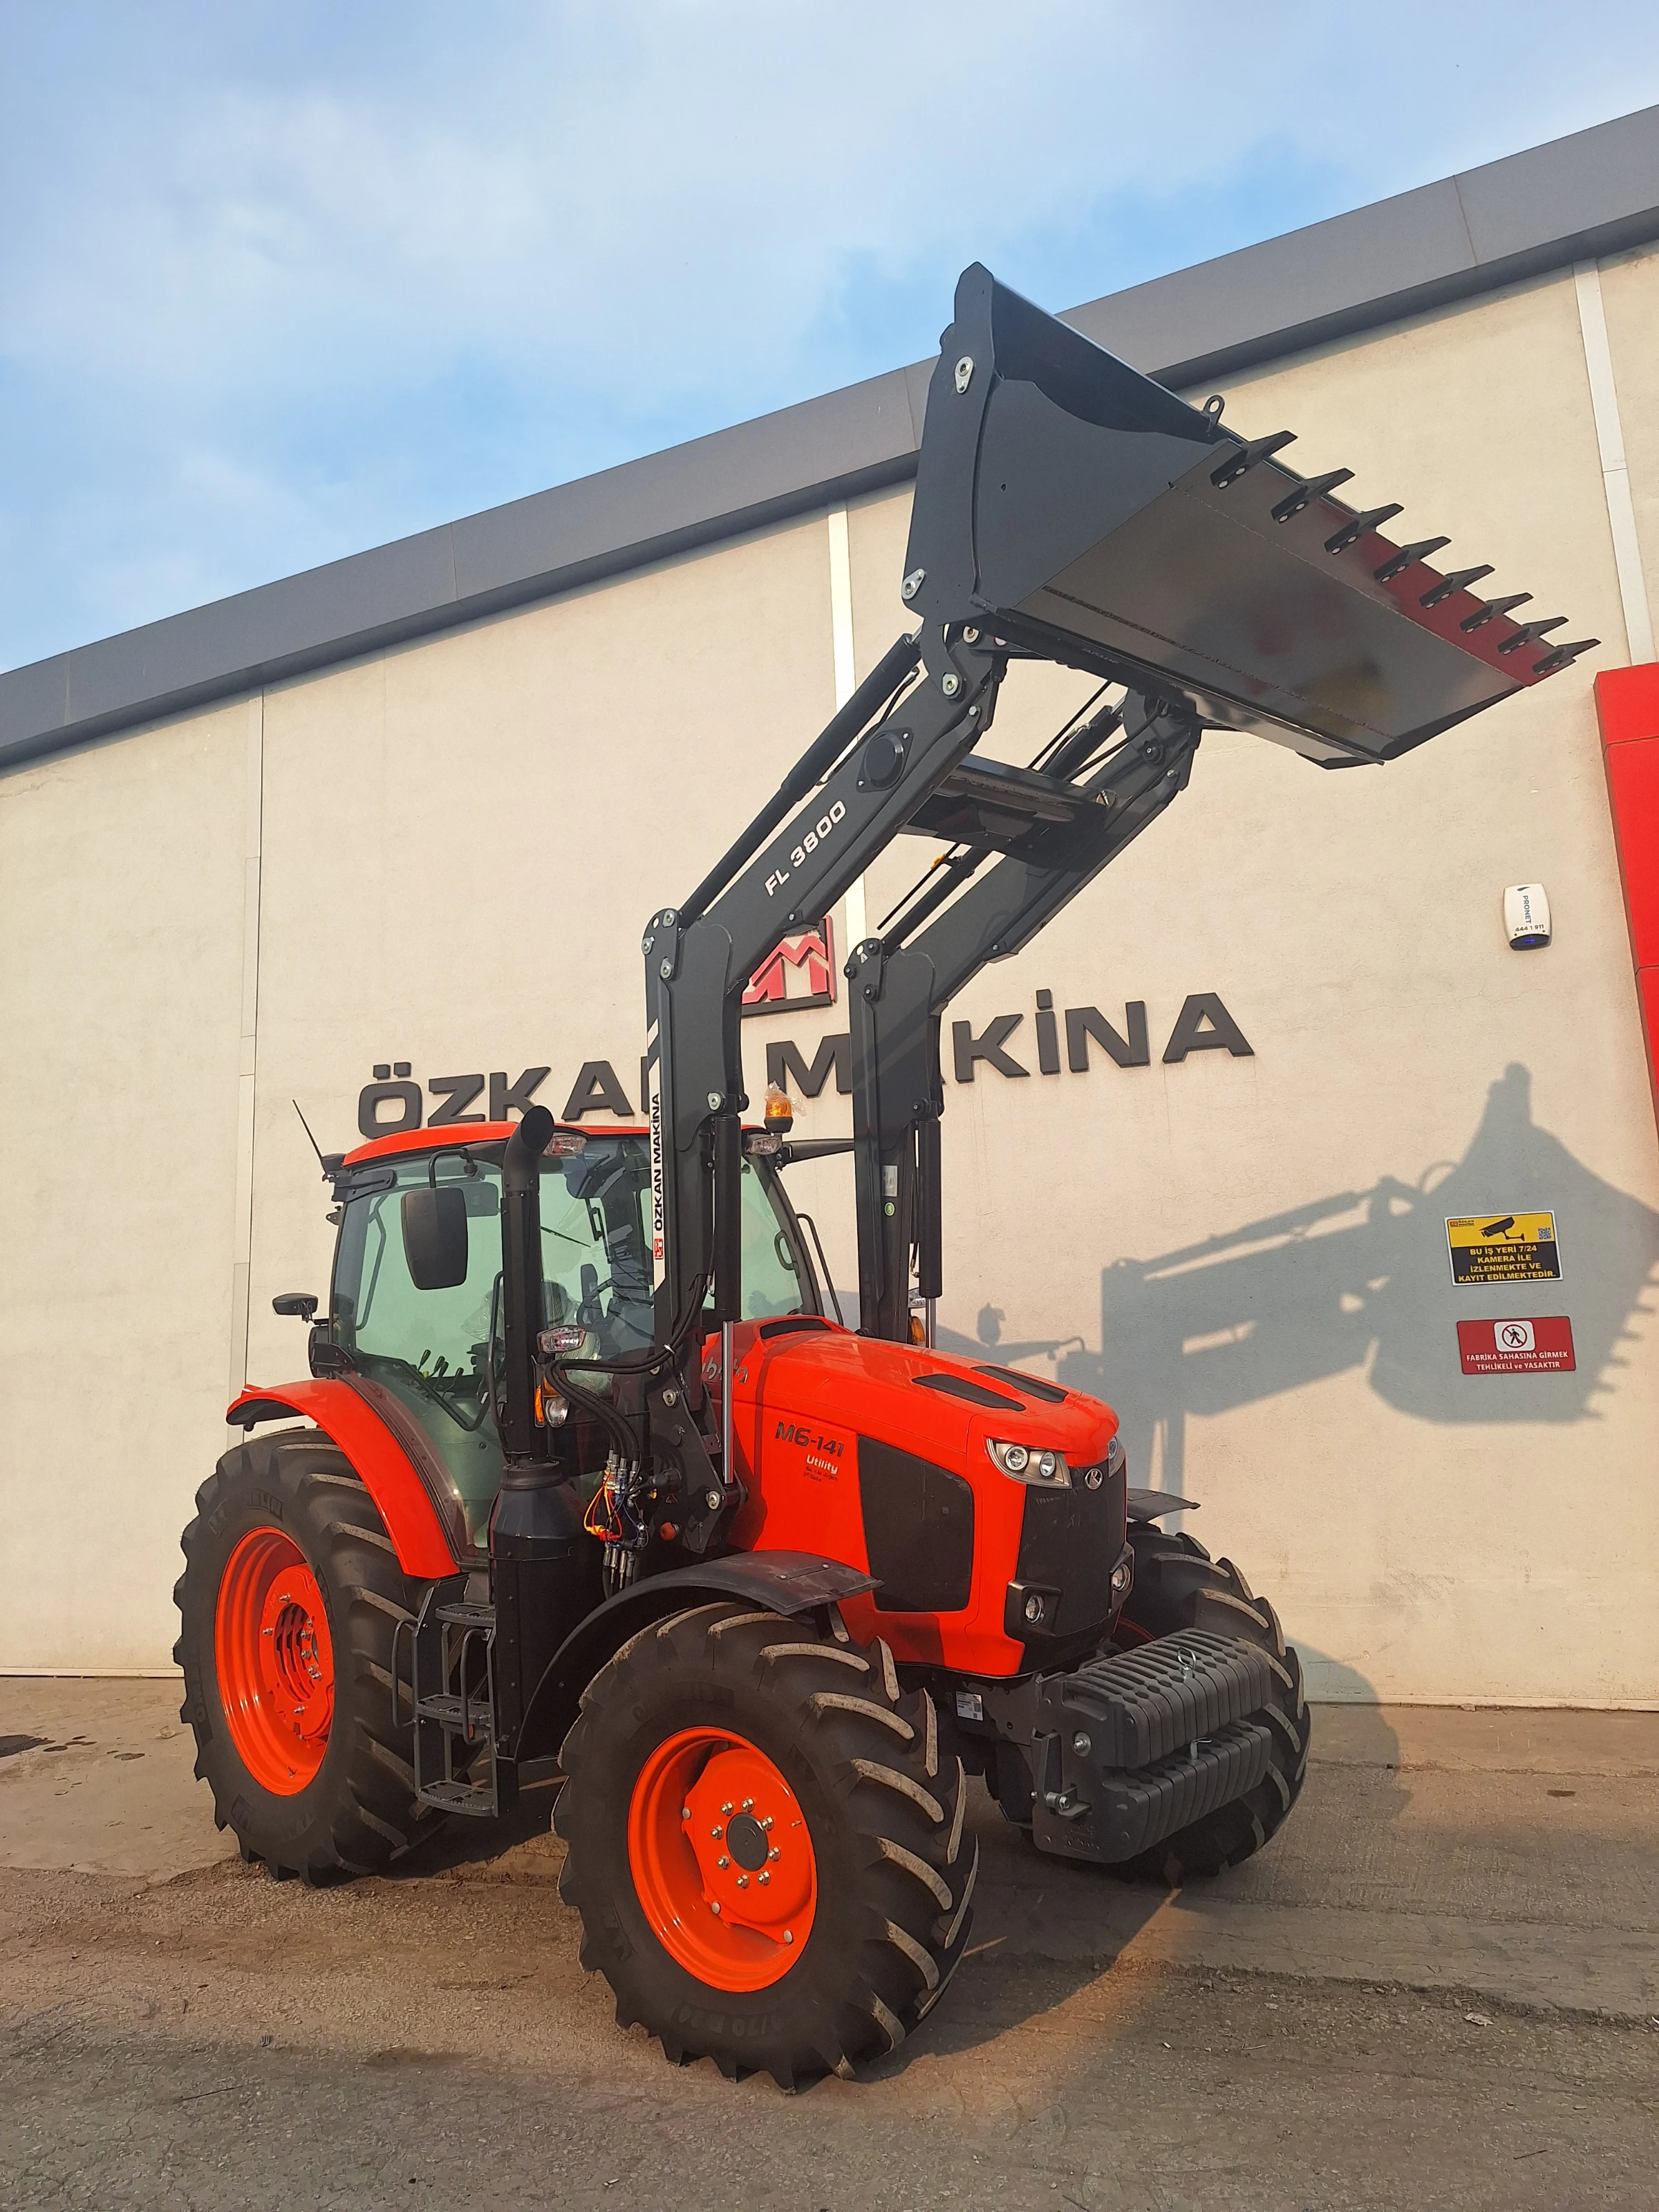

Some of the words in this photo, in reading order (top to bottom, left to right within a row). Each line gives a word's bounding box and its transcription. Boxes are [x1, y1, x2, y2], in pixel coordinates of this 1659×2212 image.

[765, 869, 790, 897] FL
[790, 800, 846, 868] 3800
[1522, 895, 1532, 924] PRONET
[766, 988, 1255, 1098] MKİNA
[651, 1093, 661, 1164] MAKİNA
[654, 1169, 663, 1231] ÖZKAN
[1477, 1255, 1515, 1264] KAMERA
[1485, 1247, 1494, 1255] İŞ
[1496, 1245, 1517, 1253] YERİ
[1470, 1263, 1527, 1273] İZLENMEKTE
[1488, 1271, 1556, 1280] EDİLMEKTEDİR.
[1466, 1353, 1497, 1361] FABRİKA
[1499, 1352, 1537, 1360] SAHASINA
[1477, 1362, 1512, 1371] TEHLİKELİ
[776, 1421, 844, 1457] M6-141
[806, 1454, 838, 1474] Utility
